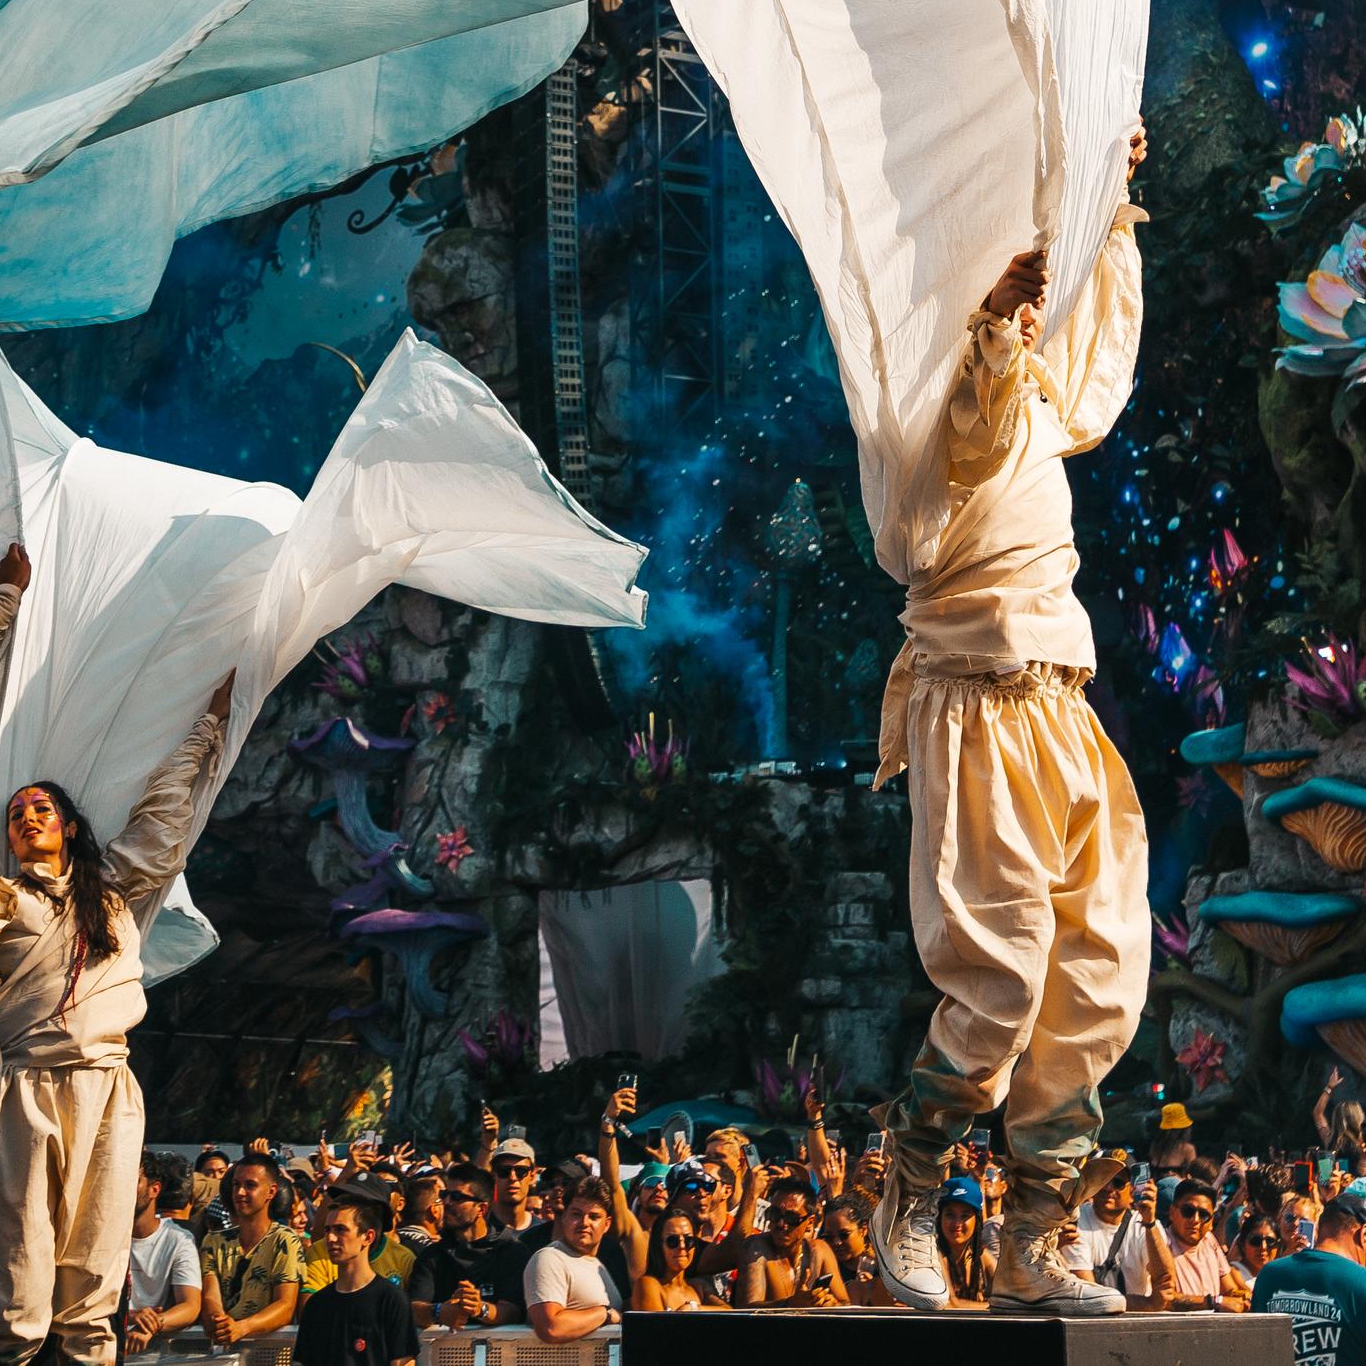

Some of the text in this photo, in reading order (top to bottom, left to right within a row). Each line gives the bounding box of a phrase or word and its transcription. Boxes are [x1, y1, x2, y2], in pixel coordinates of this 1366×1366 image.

[1267, 1299, 1342, 1322] TOMORROWLAND 24
[1291, 1327, 1342, 1354] REW
